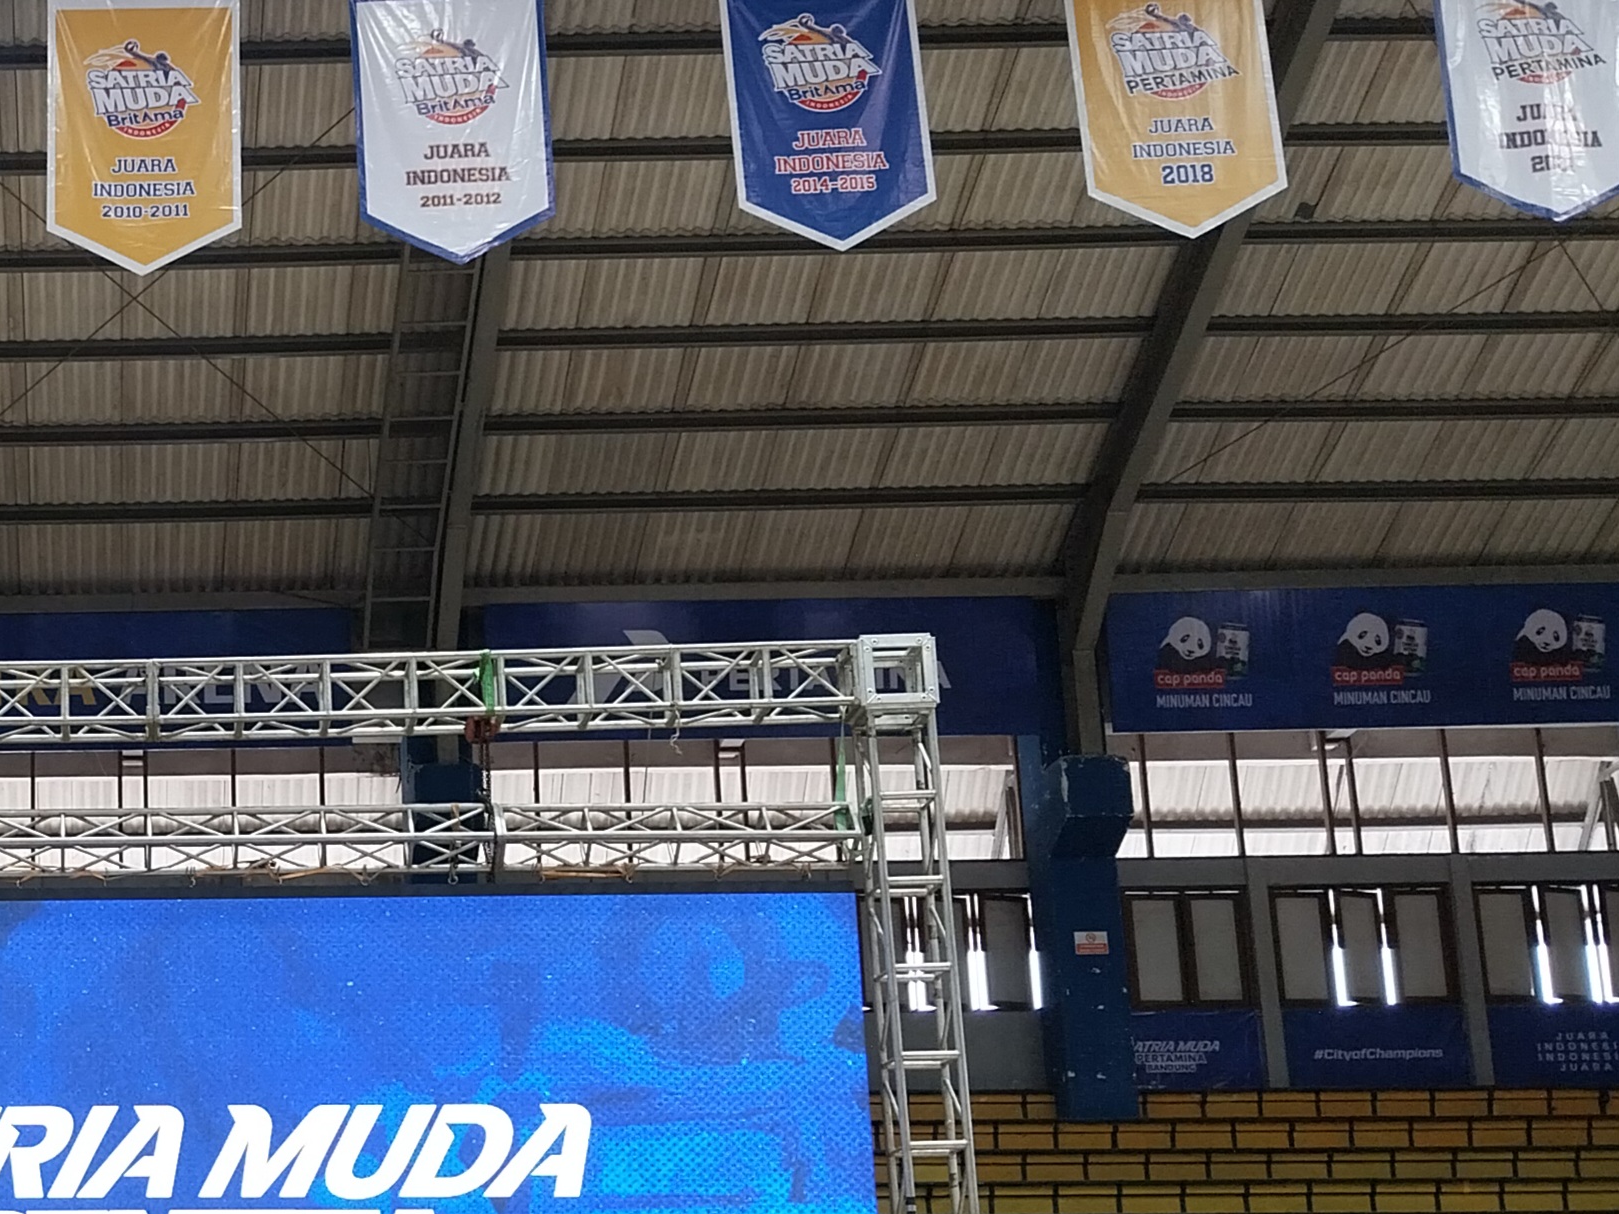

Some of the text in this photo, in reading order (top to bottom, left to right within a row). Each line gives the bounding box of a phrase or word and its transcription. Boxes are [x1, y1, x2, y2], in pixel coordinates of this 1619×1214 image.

[1477, 18, 1584, 36] SATRIA
[1111, 31, 1218, 51] SATRIA
[1482, 34, 1594, 65] MUDA
[763, 42, 873, 64] SATRIA
[1116, 46, 1228, 78] MUDA
[395, 55, 500, 79] SATRIA
[770, 58, 882, 89] MUDA
[1491, 54, 1607, 81] PERTAMINA
[88, 70, 193, 89] SATRIA
[400, 71, 509, 104] MUDA
[1126, 64, 1240, 95] PERTAMINA
[93, 85, 200, 115] MUDA
[787, 80, 867, 102] BritAma
[416, 93, 495, 116] BritAma
[107, 108, 185, 128] BritAma
[1149, 117, 1215, 134] JUARA
[792, 128, 867, 150] JUARA
[423, 142, 490, 160] JUARA
[1132, 140, 1236, 159] INDONESIA
[111, 157, 177, 174] JUARA
[775, 152, 889, 174] INDONESIA
[405, 166, 510, 186] INDONESIA
[1161, 164, 1214, 185] 2018
[93, 181, 196, 198] INDONESIA
[791, 175, 877, 194] 2014-2015
[420, 192, 502, 208] 2011-2012
[101, 204, 190, 219] 2010-2011
[1157, 671, 1223, 687] cap panda
[1334, 668, 1401, 683] cap panda
[1513, 664, 1580, 679] cap panda
[1156, 693, 1253, 708] MINUMAN CINCAU
[1334, 690, 1431, 705] MINUMAN CINCAU
[1513, 685, 1611, 700] MINUMAN CINCAU
[1133, 1040, 1220, 1052] ATRIA MUDA
[1314, 1047, 1444, 1062] #CityofChampions
[1135, 1053, 1207, 1065] PERTAMINA
[199, 1103, 593, 1201] MUDA
